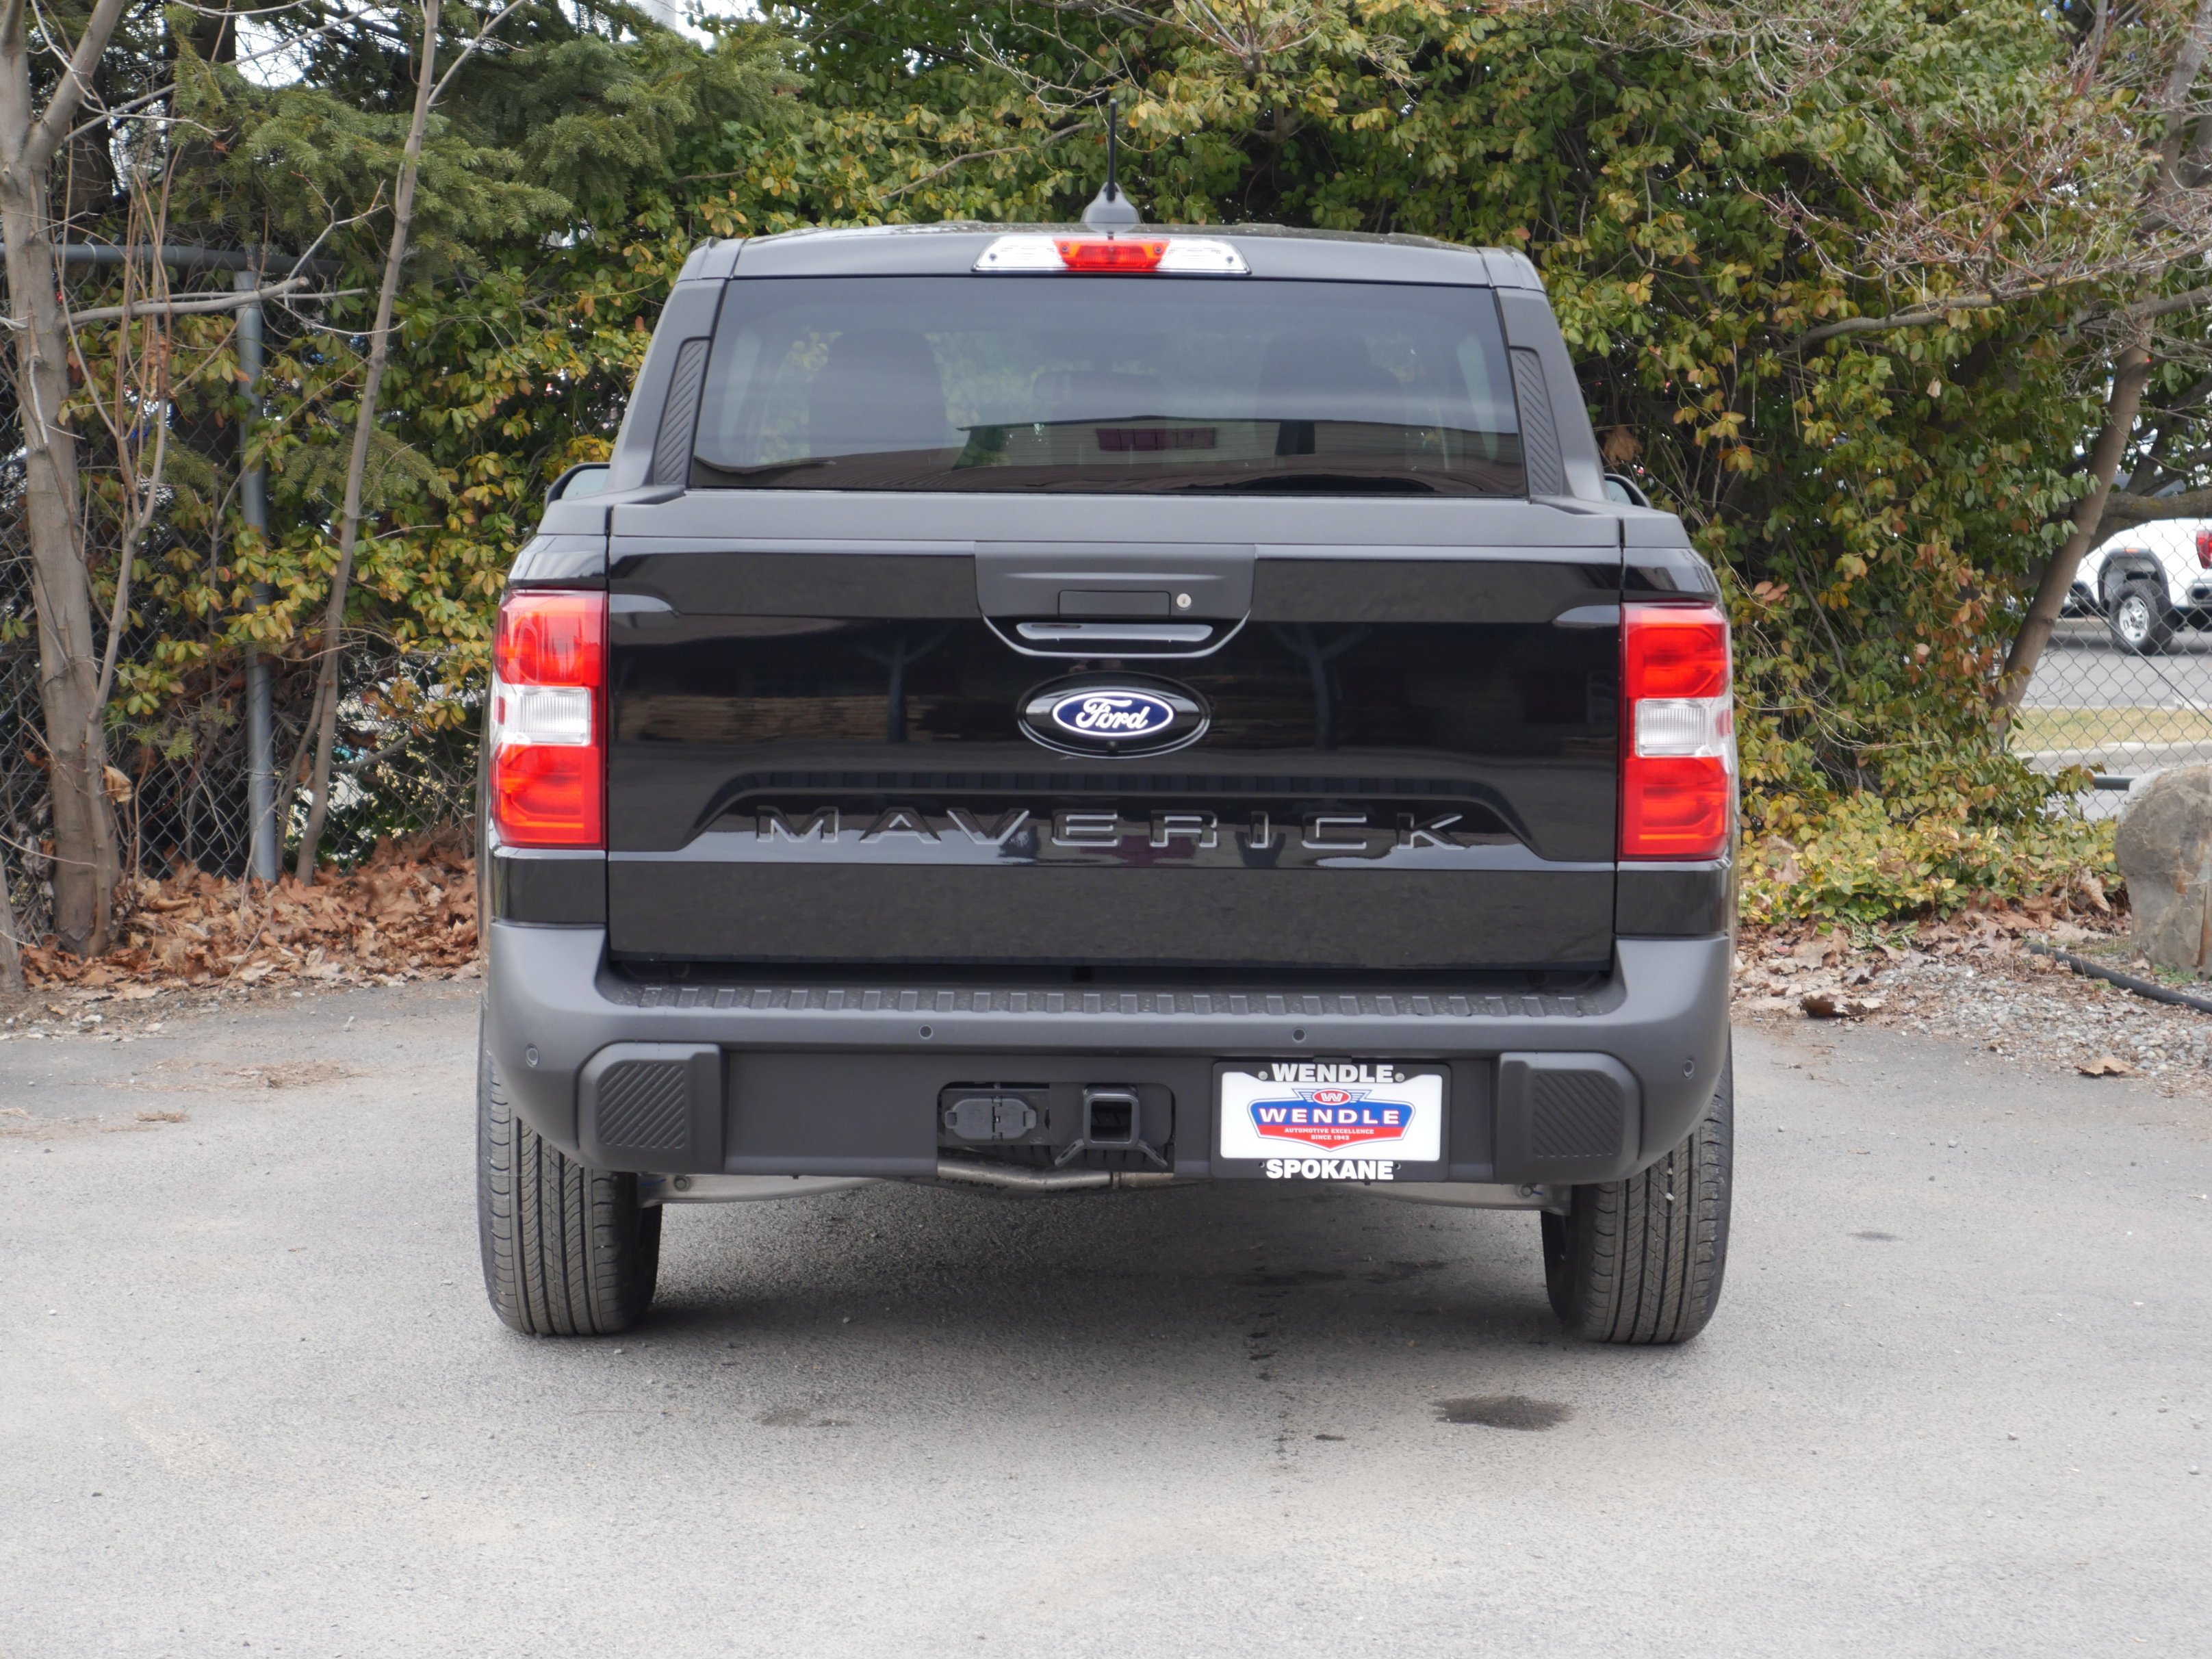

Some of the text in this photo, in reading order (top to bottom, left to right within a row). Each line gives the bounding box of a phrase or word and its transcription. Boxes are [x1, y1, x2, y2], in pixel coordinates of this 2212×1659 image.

[1075, 697, 1150, 729] Ford
[757, 806, 1467, 850] MAVERICK
[1272, 1063, 1394, 1083] WENDLE
[1320, 1093, 1344, 1103] W
[1258, 1107, 1400, 1125] WENDLE
[1265, 1159, 1394, 1180] SPOKANE
